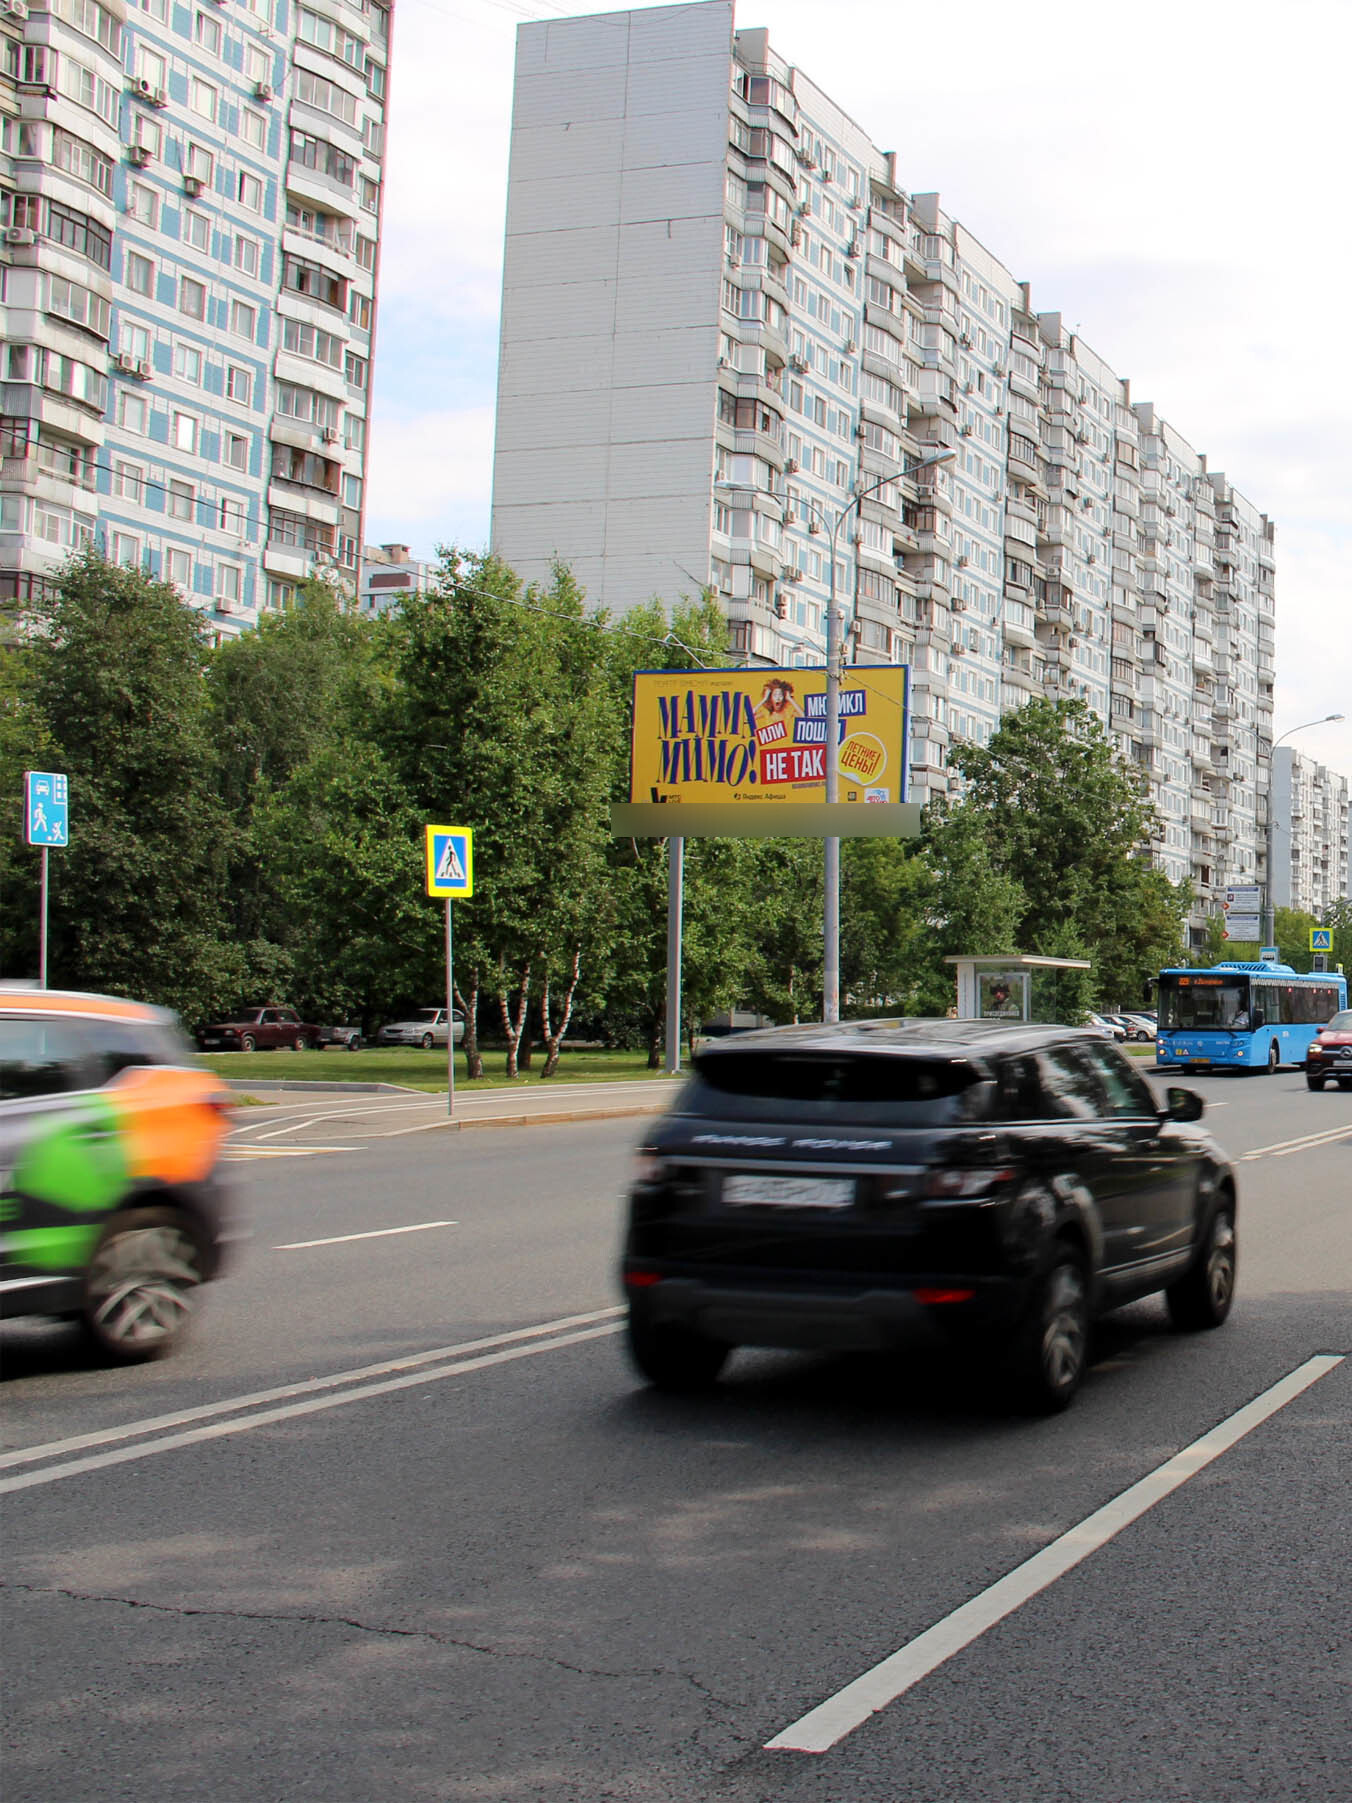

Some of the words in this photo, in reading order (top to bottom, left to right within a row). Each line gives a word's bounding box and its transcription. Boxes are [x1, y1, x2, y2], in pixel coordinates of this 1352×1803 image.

[657, 690, 757, 739] МАММА
[807, 693, 864, 716] МЮИКЛ
[759, 722, 786, 745] ИЛИ
[656, 738, 757, 787] МИМО!
[841, 751, 880, 777] ЦЕНЫ!
[846, 741, 877, 761] ЛЕТНИЕ
[766, 752, 788, 780] НЕ
[791, 749, 824, 778] ТАК
